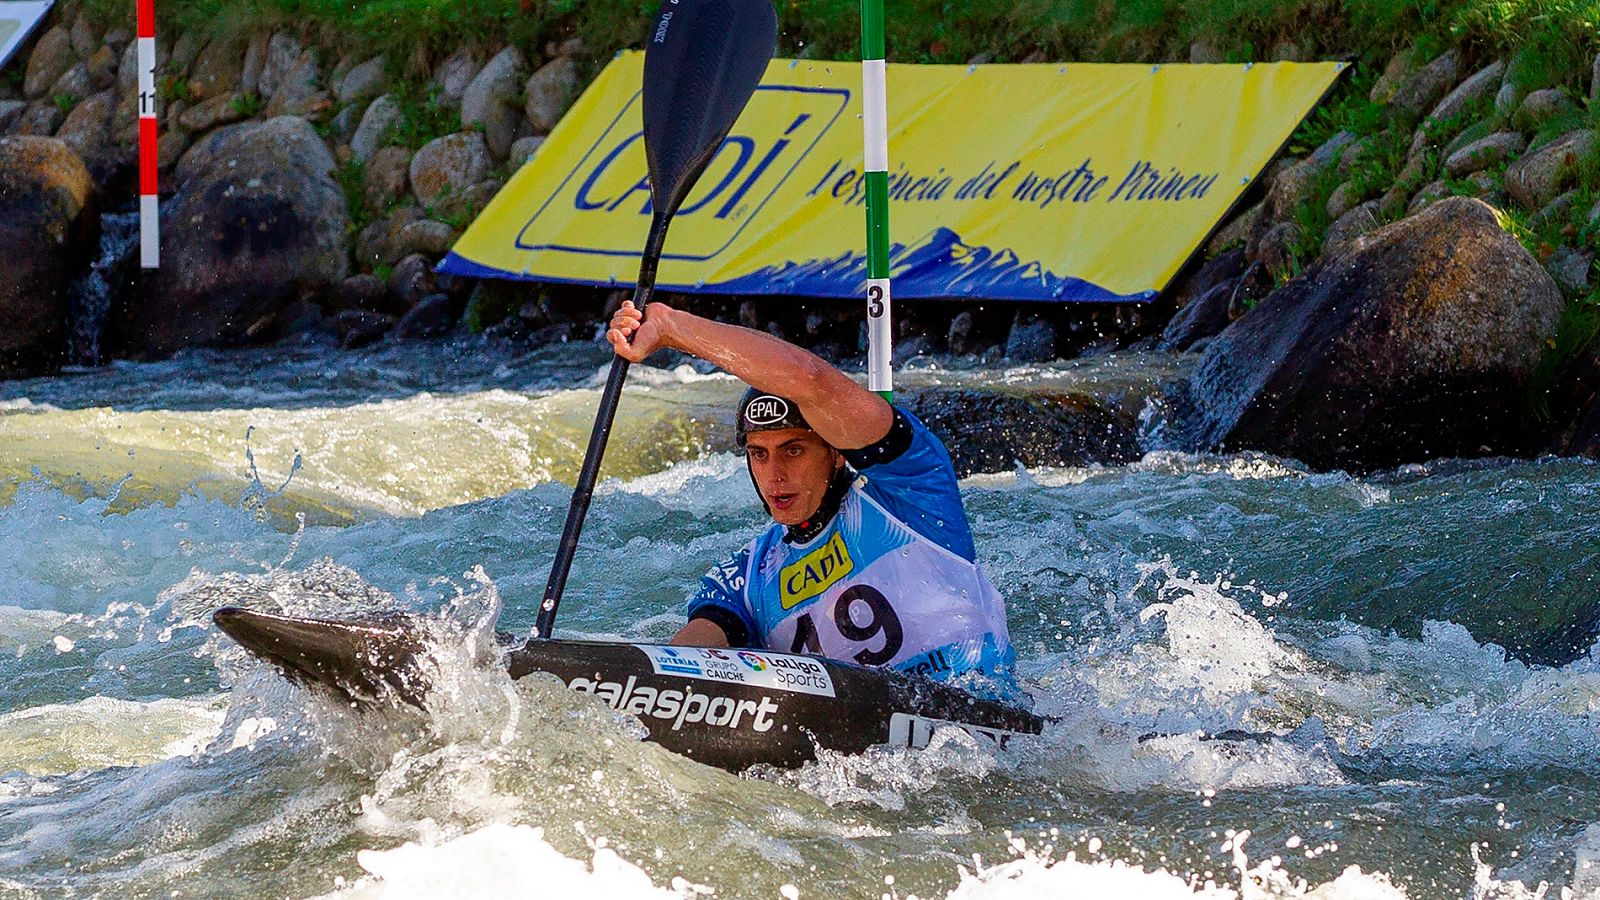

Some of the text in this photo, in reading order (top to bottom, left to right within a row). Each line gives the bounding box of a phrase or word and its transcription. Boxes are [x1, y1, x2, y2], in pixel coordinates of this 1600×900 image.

[954, 160, 1021, 200] del
[1012, 157, 1109, 209] nostre
[1107, 160, 1219, 202] Pirineu
[868, 285, 884, 318] 3
[750, 401, 782, 419] EPAL
[705, 660, 738, 672] GRUPO
[765, 656, 822, 674] LaLiga
[706, 669, 745, 682] CALICHE
[776, 668, 827, 689] Sports
